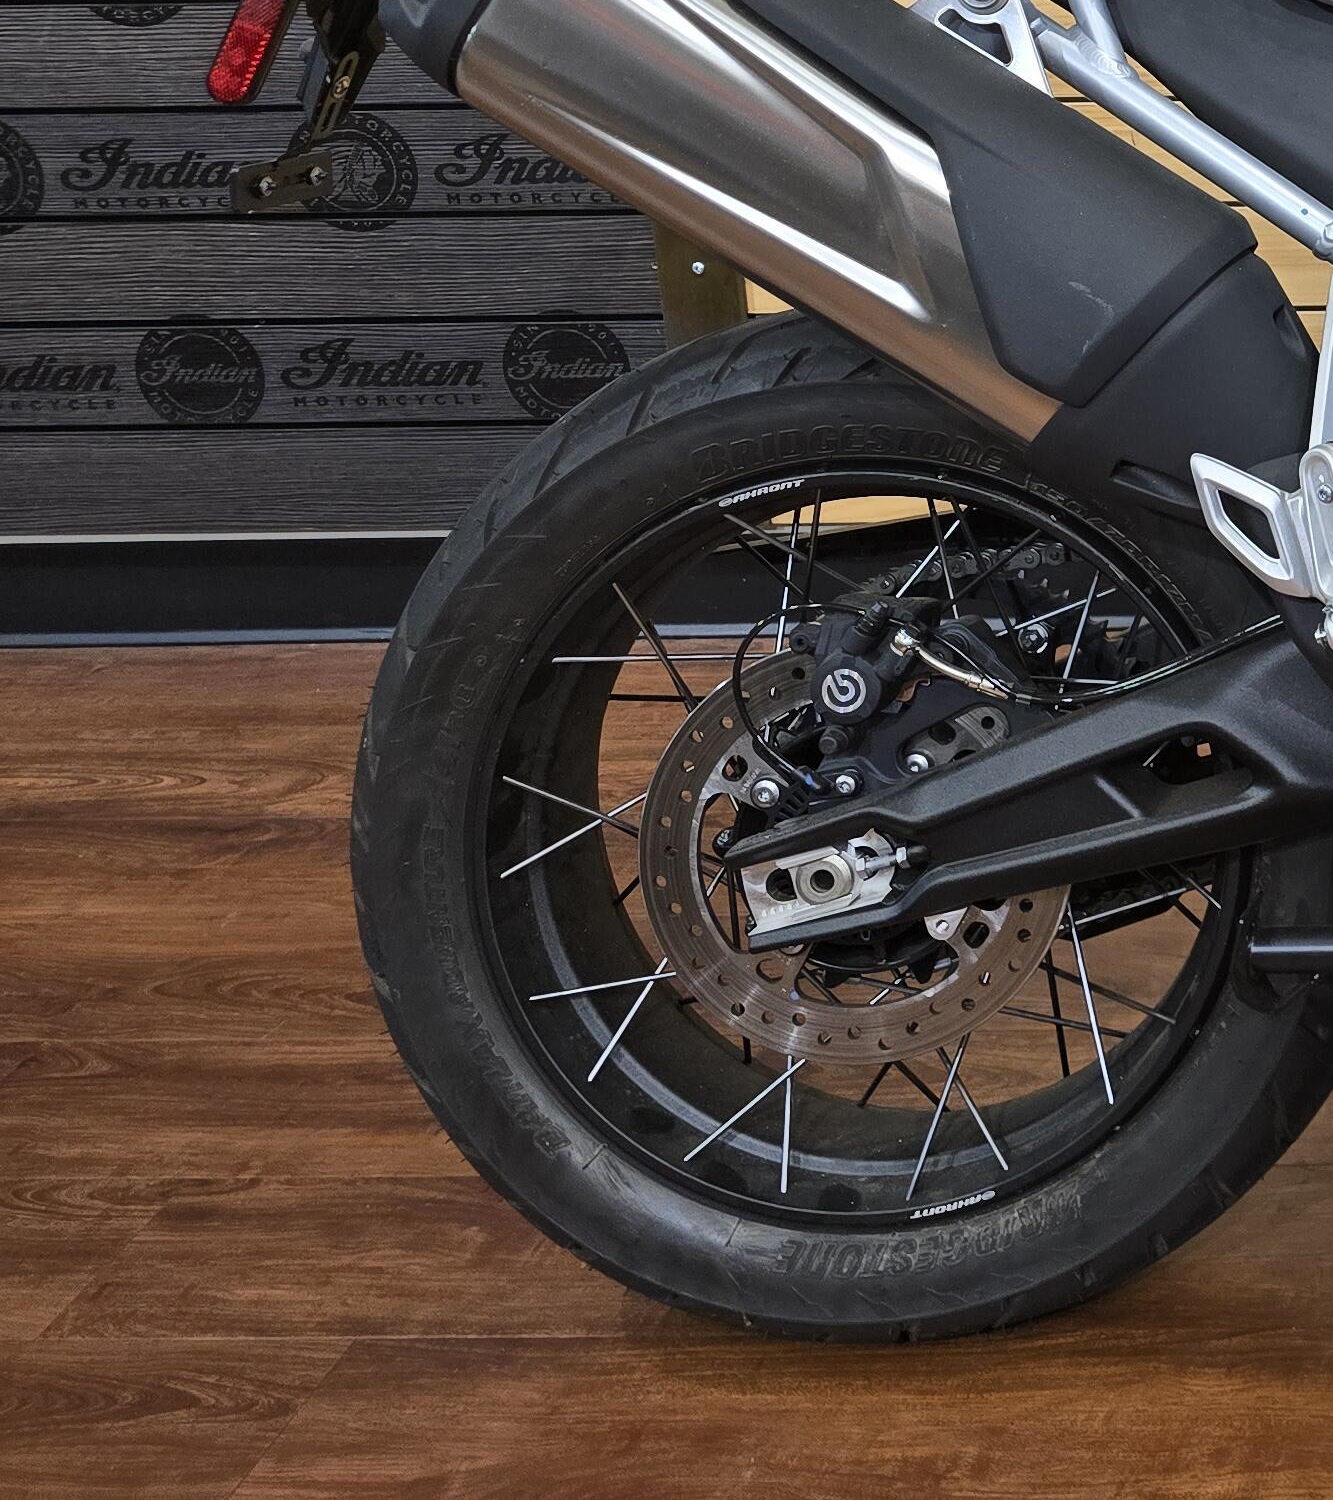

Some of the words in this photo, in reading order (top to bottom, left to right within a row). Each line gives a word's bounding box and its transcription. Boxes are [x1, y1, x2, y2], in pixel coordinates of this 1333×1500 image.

[60, 138, 237, 191] India
[73, 196, 230, 209] MOTORCYC
[0, 355, 117, 393] dian
[281, 338, 484, 390] Indian
[507, 350, 625, 381] Indian
[293, 395, 482, 407] MOTORCYCLE
[690, 422, 1006, 484] BRIDGESTONE
